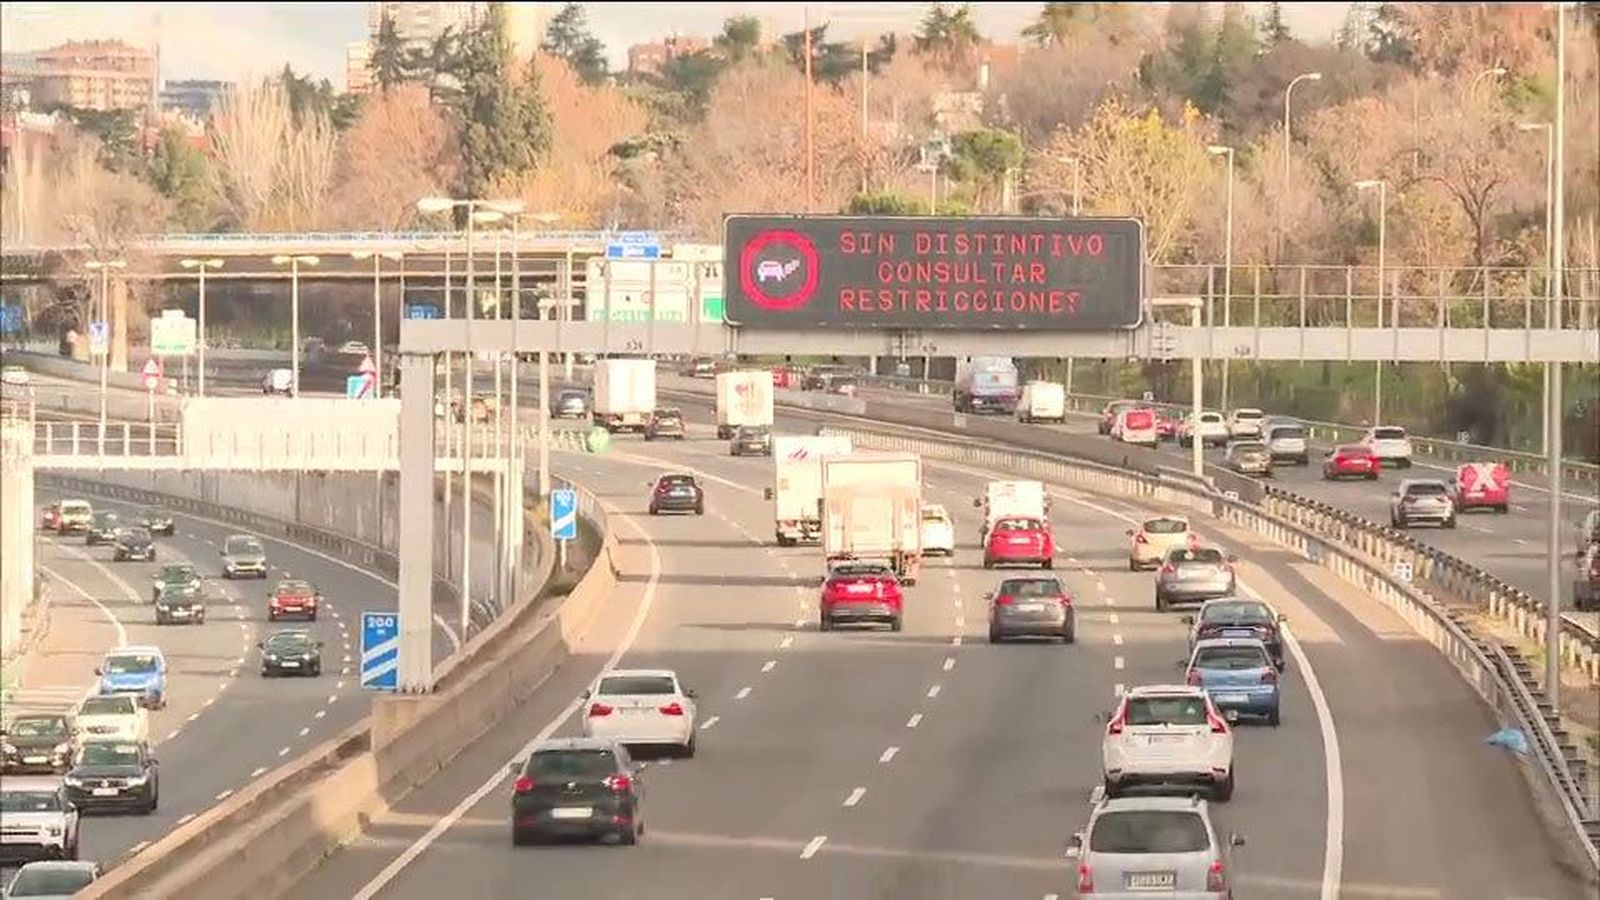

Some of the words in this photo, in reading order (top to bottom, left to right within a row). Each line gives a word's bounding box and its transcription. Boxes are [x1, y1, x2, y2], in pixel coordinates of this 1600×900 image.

[840, 232, 894, 255] SIN
[915, 233, 1103, 256] DISTINTIVO
[878, 261, 1047, 284] CONSULTAR
